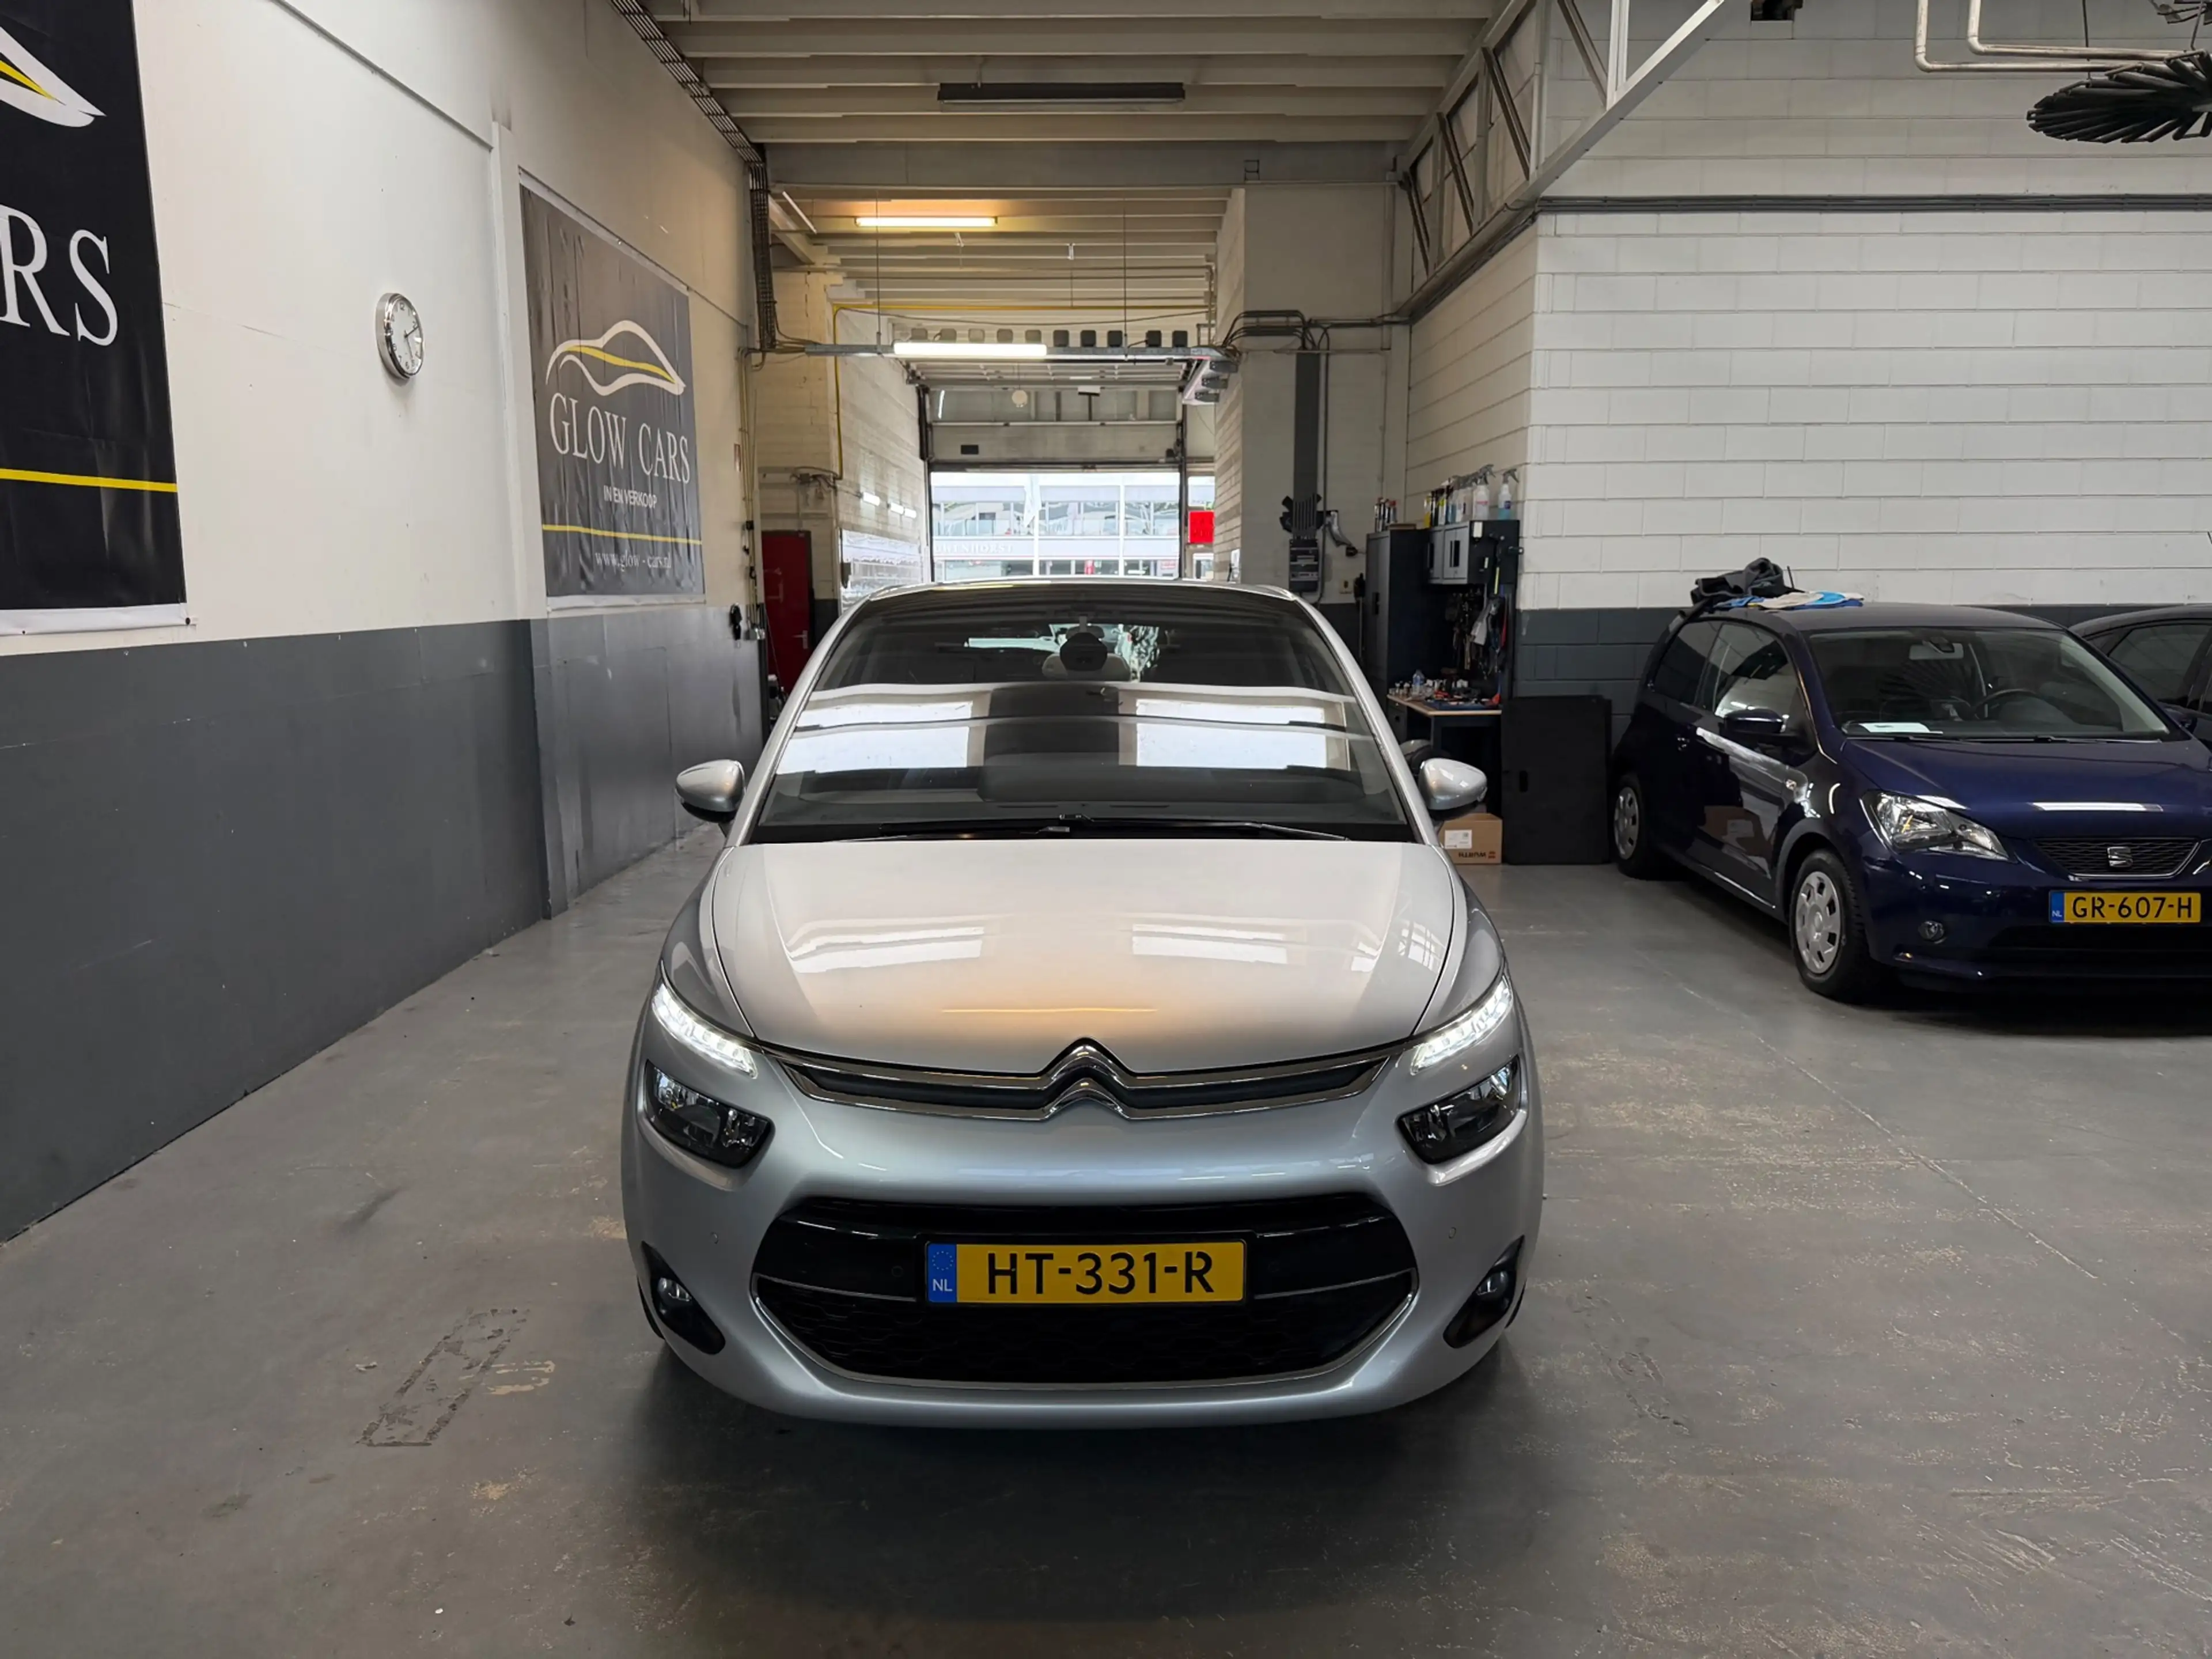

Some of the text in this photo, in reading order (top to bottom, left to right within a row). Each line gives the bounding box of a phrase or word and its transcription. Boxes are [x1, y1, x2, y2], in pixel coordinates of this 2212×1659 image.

[0, 204, 118, 346] RS
[550, 392, 690, 484] GLOW CARS
[2072, 896, 2192, 919] GR-607-H
[933, 1251, 1214, 1295] NL HT-331-R
